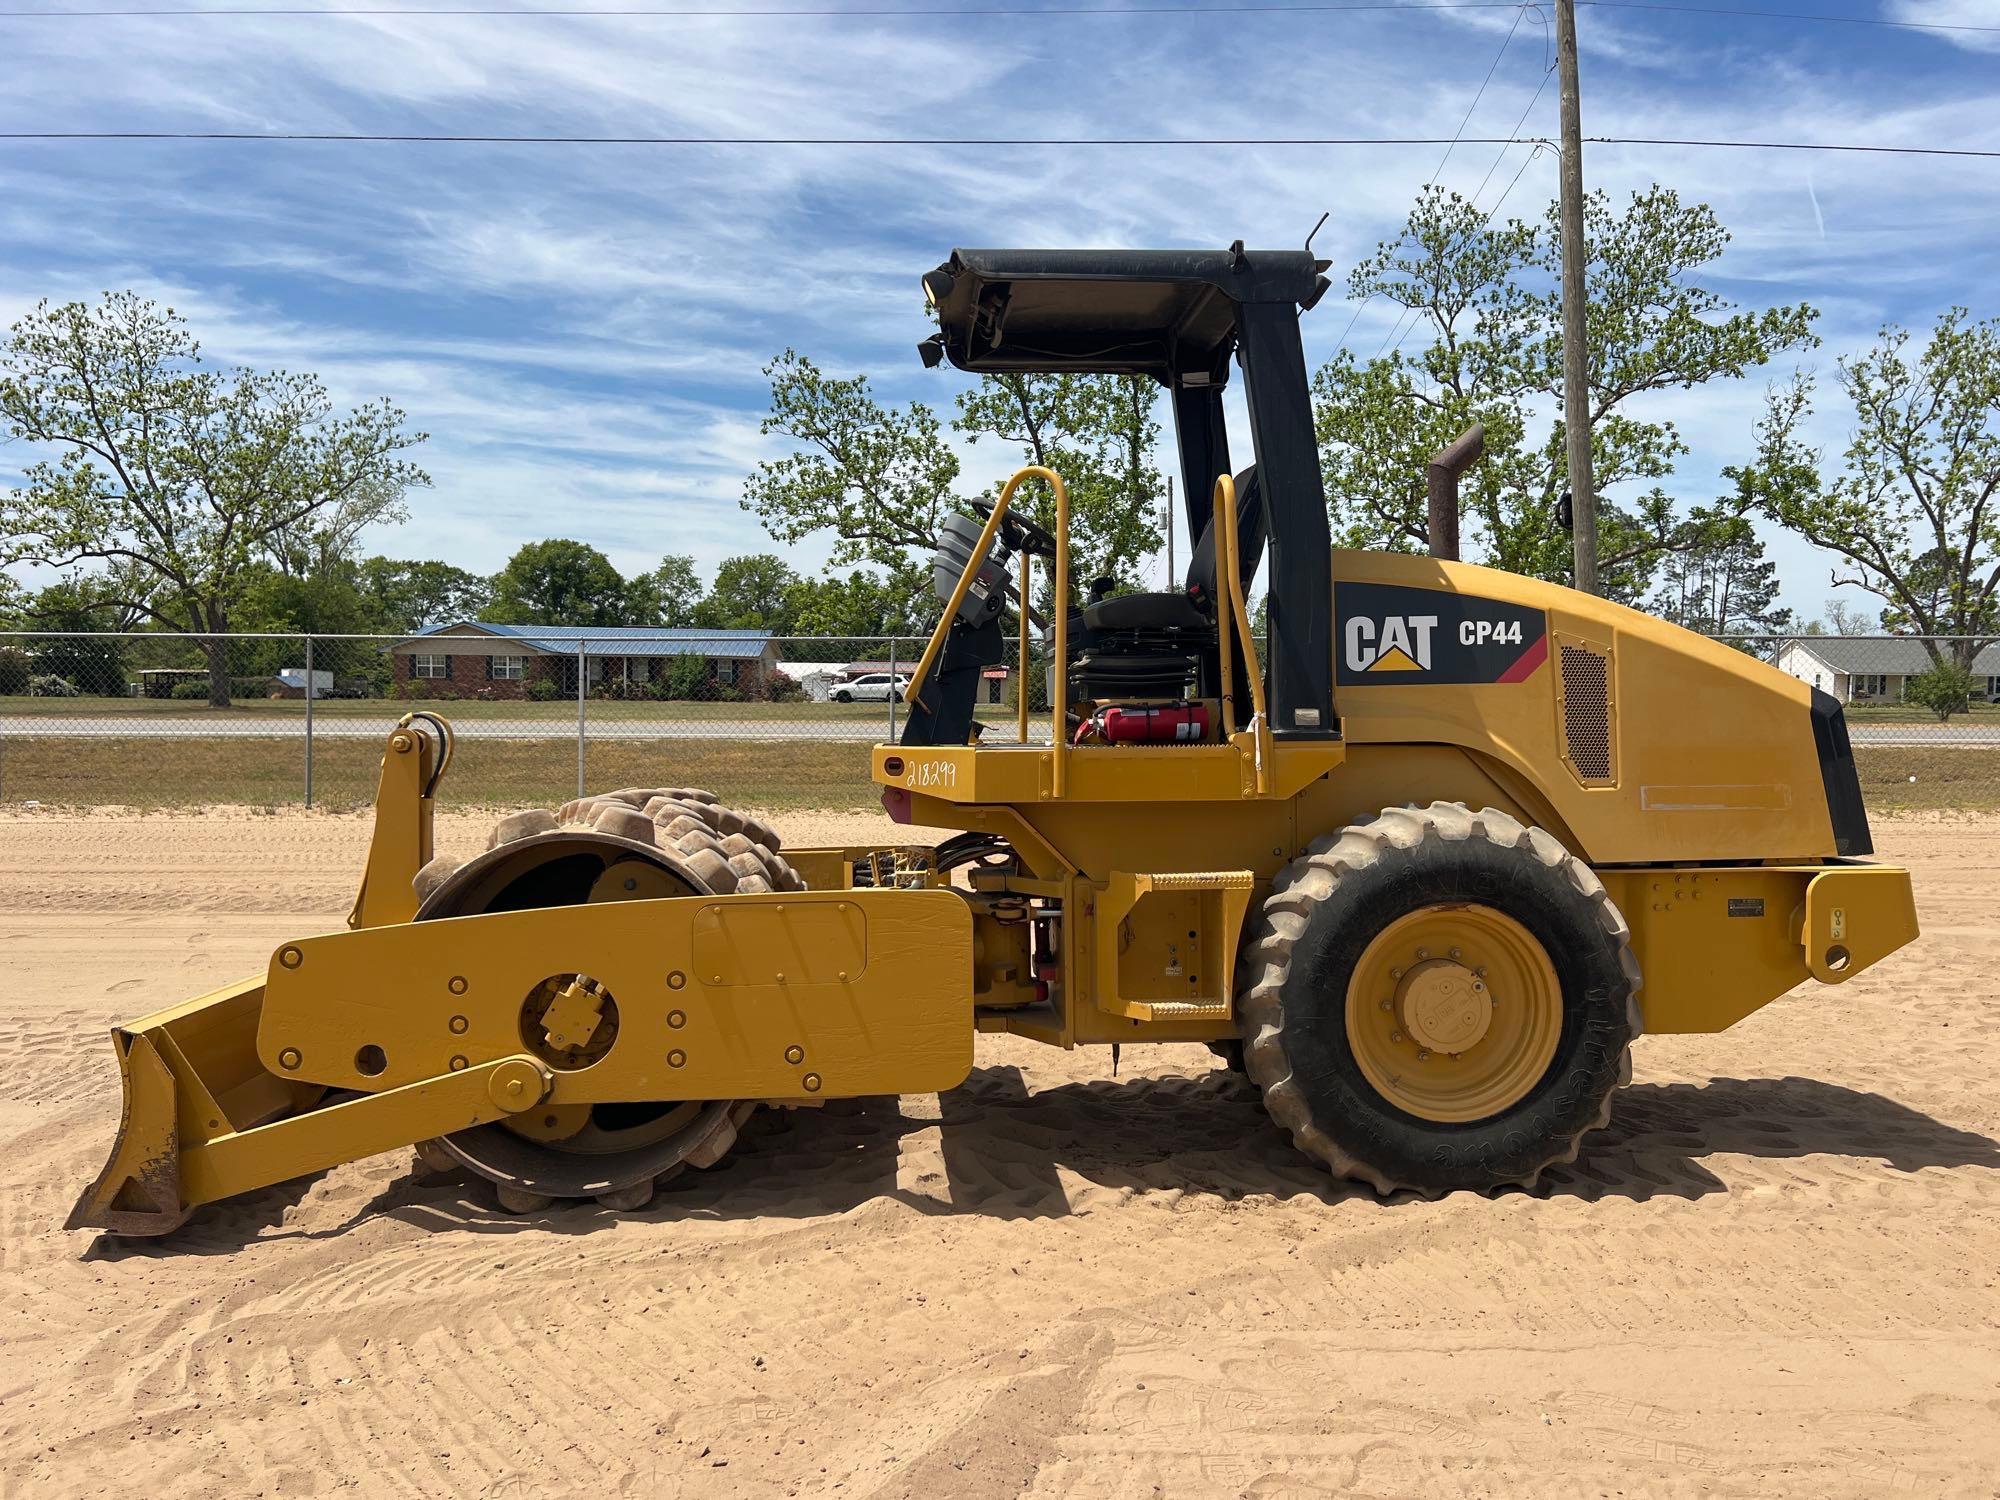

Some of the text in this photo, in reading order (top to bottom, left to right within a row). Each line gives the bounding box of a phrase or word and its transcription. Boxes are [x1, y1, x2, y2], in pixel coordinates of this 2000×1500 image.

[1345, 615, 1523, 672] CAT CP44
[906, 760, 956, 787] 218299
